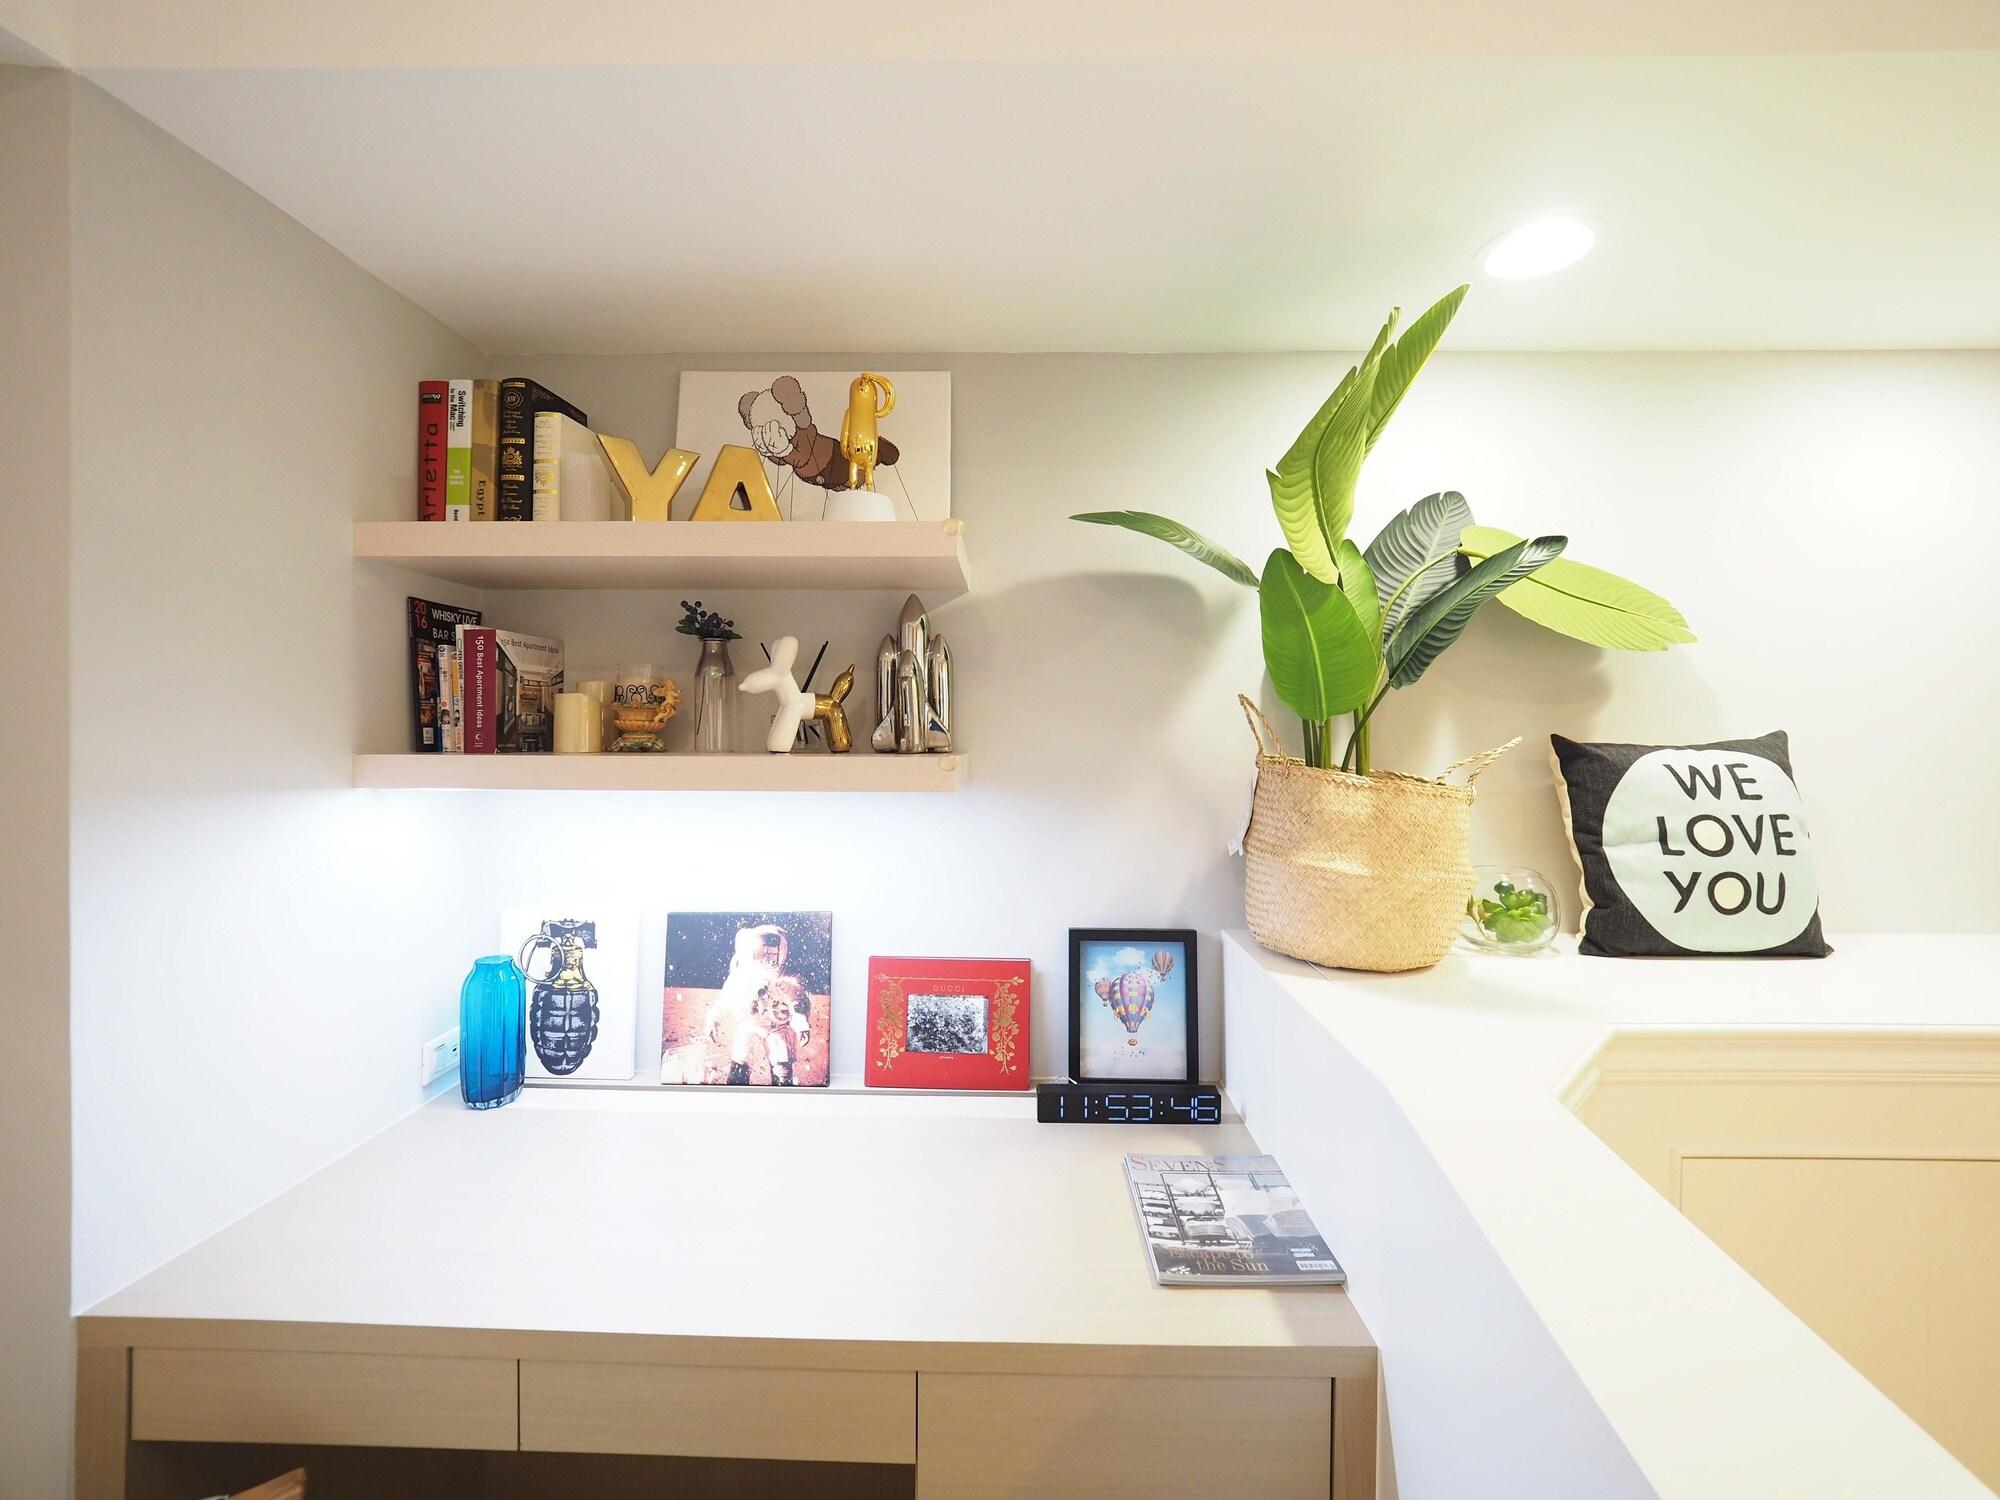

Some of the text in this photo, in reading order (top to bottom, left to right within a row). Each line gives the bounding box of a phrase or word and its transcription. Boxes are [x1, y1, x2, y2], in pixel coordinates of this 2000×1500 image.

[456, 390, 466, 428] Switching
[476, 480, 487, 517] Egypt
[414, 600, 427, 615] 20
[431, 608, 461, 623] WHISKY
[462, 614, 478, 625] LIVE
[415, 615, 428, 629] 16
[432, 628, 449, 641] BAR
[500, 639, 510, 648] 150
[511, 638, 523, 648] Best
[523, 641, 547, 651] Apartment
[475, 635, 485, 728] 150 Best Apartment Ideas
[1663, 763, 1763, 801] WE
[1656, 813, 1797, 857] LOVE
[1663, 871, 1786, 916] YOU
[932, 984, 965, 993] GUCCI
[1060, 1095, 1218, 1121] 11:53:46
[1196, 1258, 1269, 1272] the Sun
